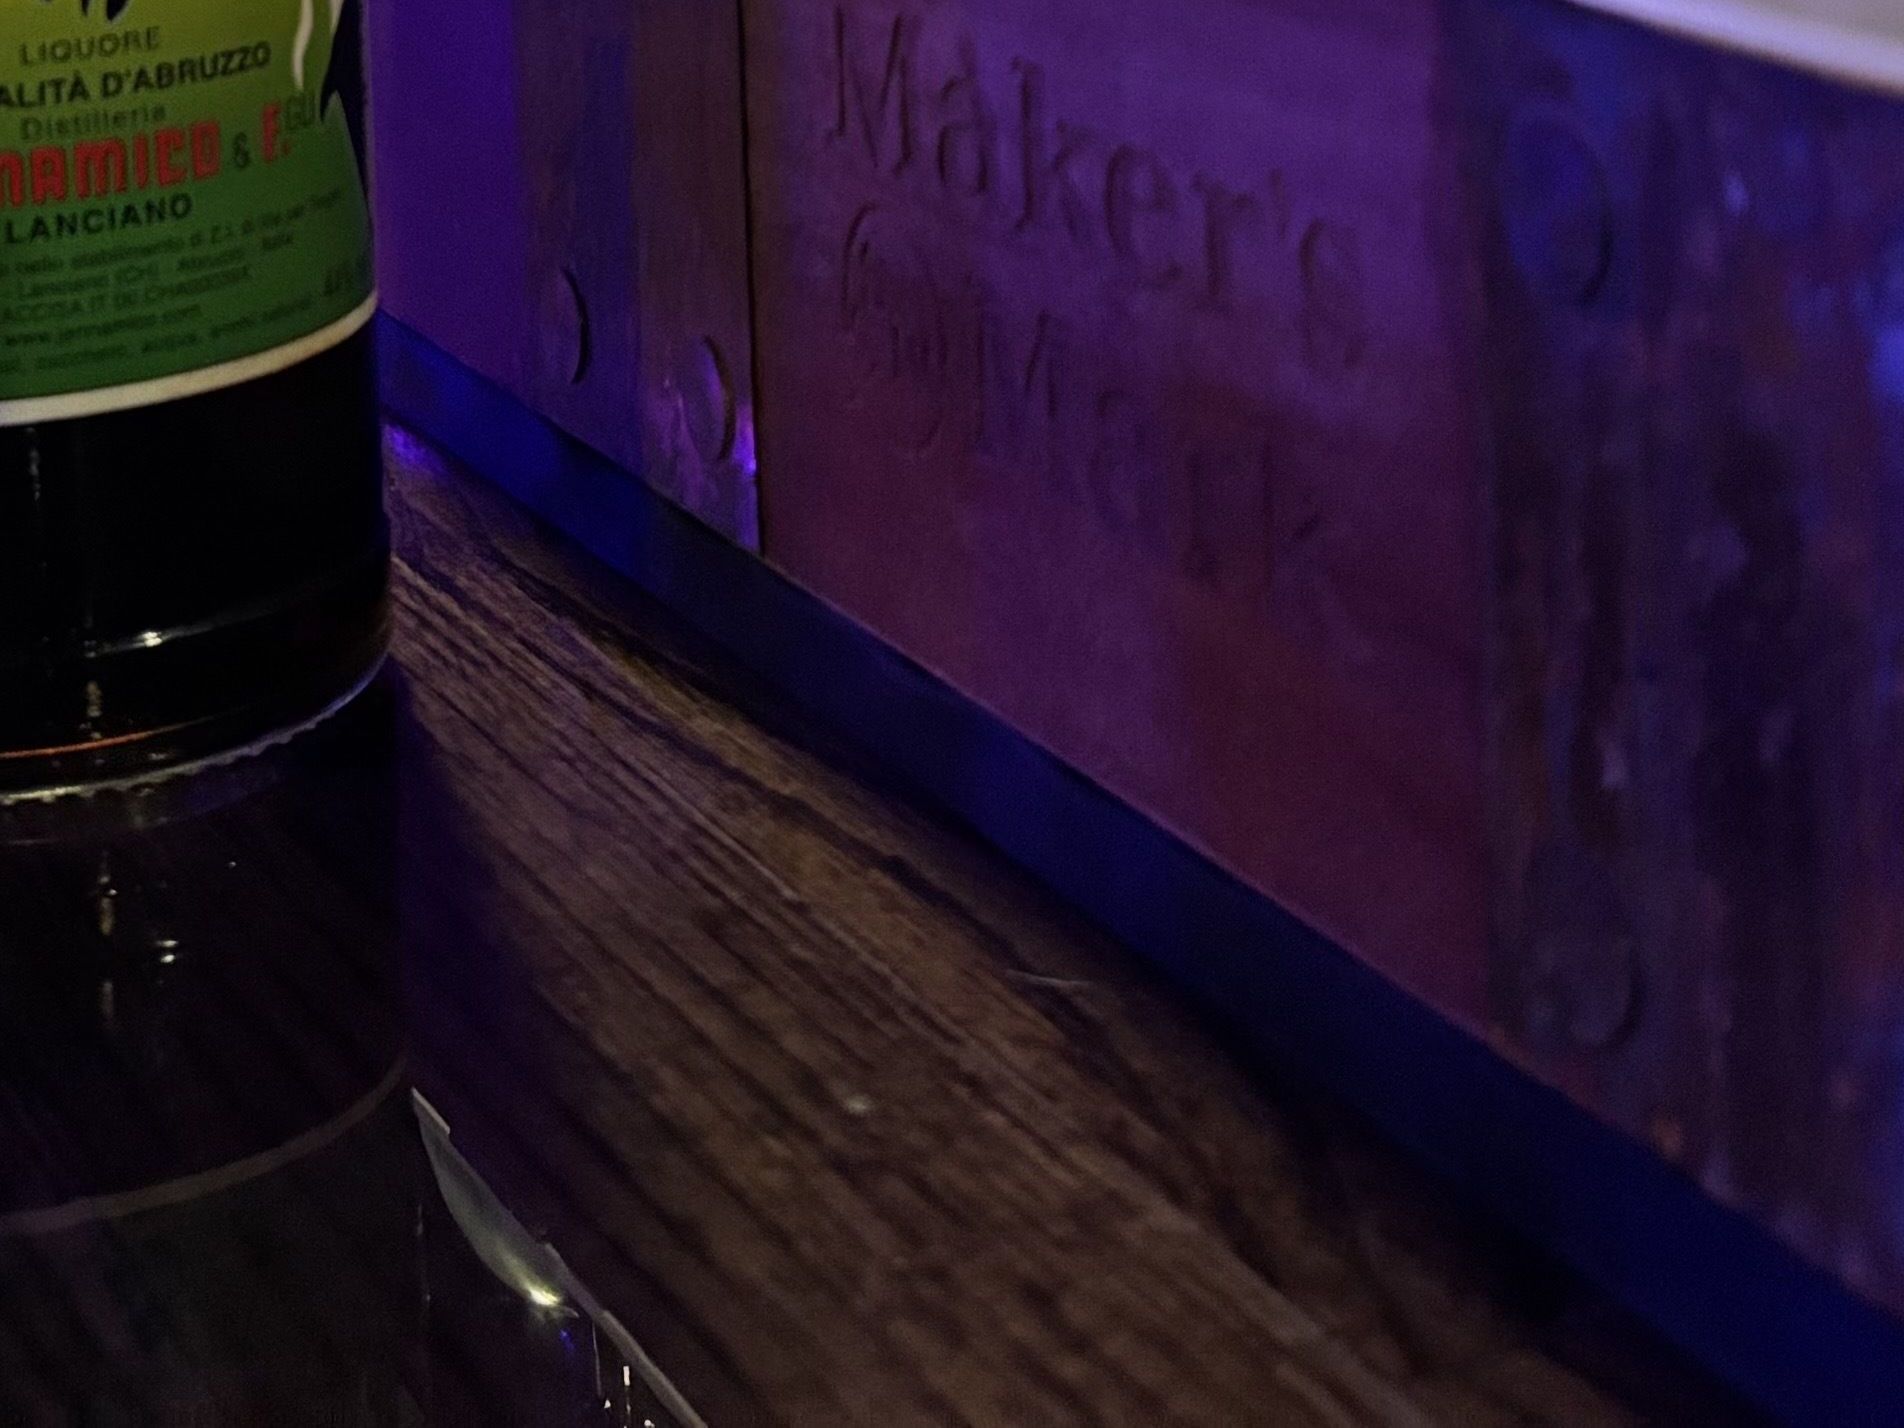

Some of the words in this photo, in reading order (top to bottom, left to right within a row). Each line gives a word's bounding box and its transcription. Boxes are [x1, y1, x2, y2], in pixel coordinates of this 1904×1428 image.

[19, 25, 162, 67] LIQUORE
[100, 40, 273, 100] D'ABRUZZO
[3, 193, 194, 245] LANCIANO
